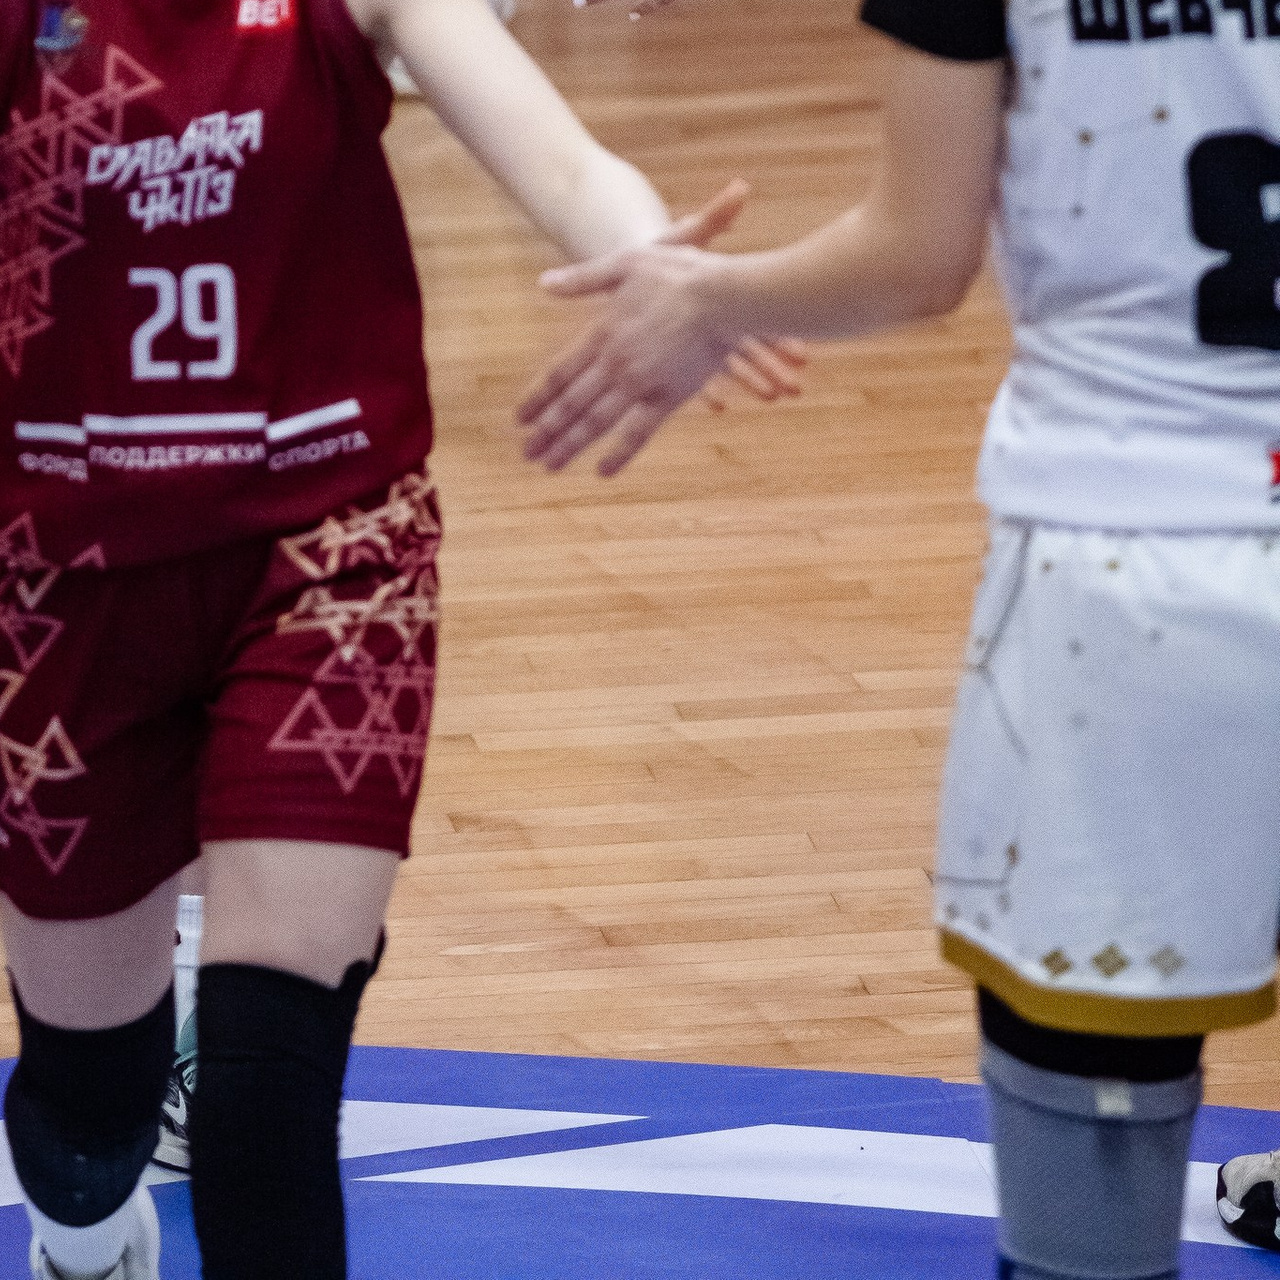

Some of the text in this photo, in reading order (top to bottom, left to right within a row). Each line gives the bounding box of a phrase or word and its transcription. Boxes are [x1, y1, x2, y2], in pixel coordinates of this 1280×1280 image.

[128, 263, 238, 380] 29
[19, 431, 369, 482] ФОНД ПОДДЕРЖКИ СПОРТА
